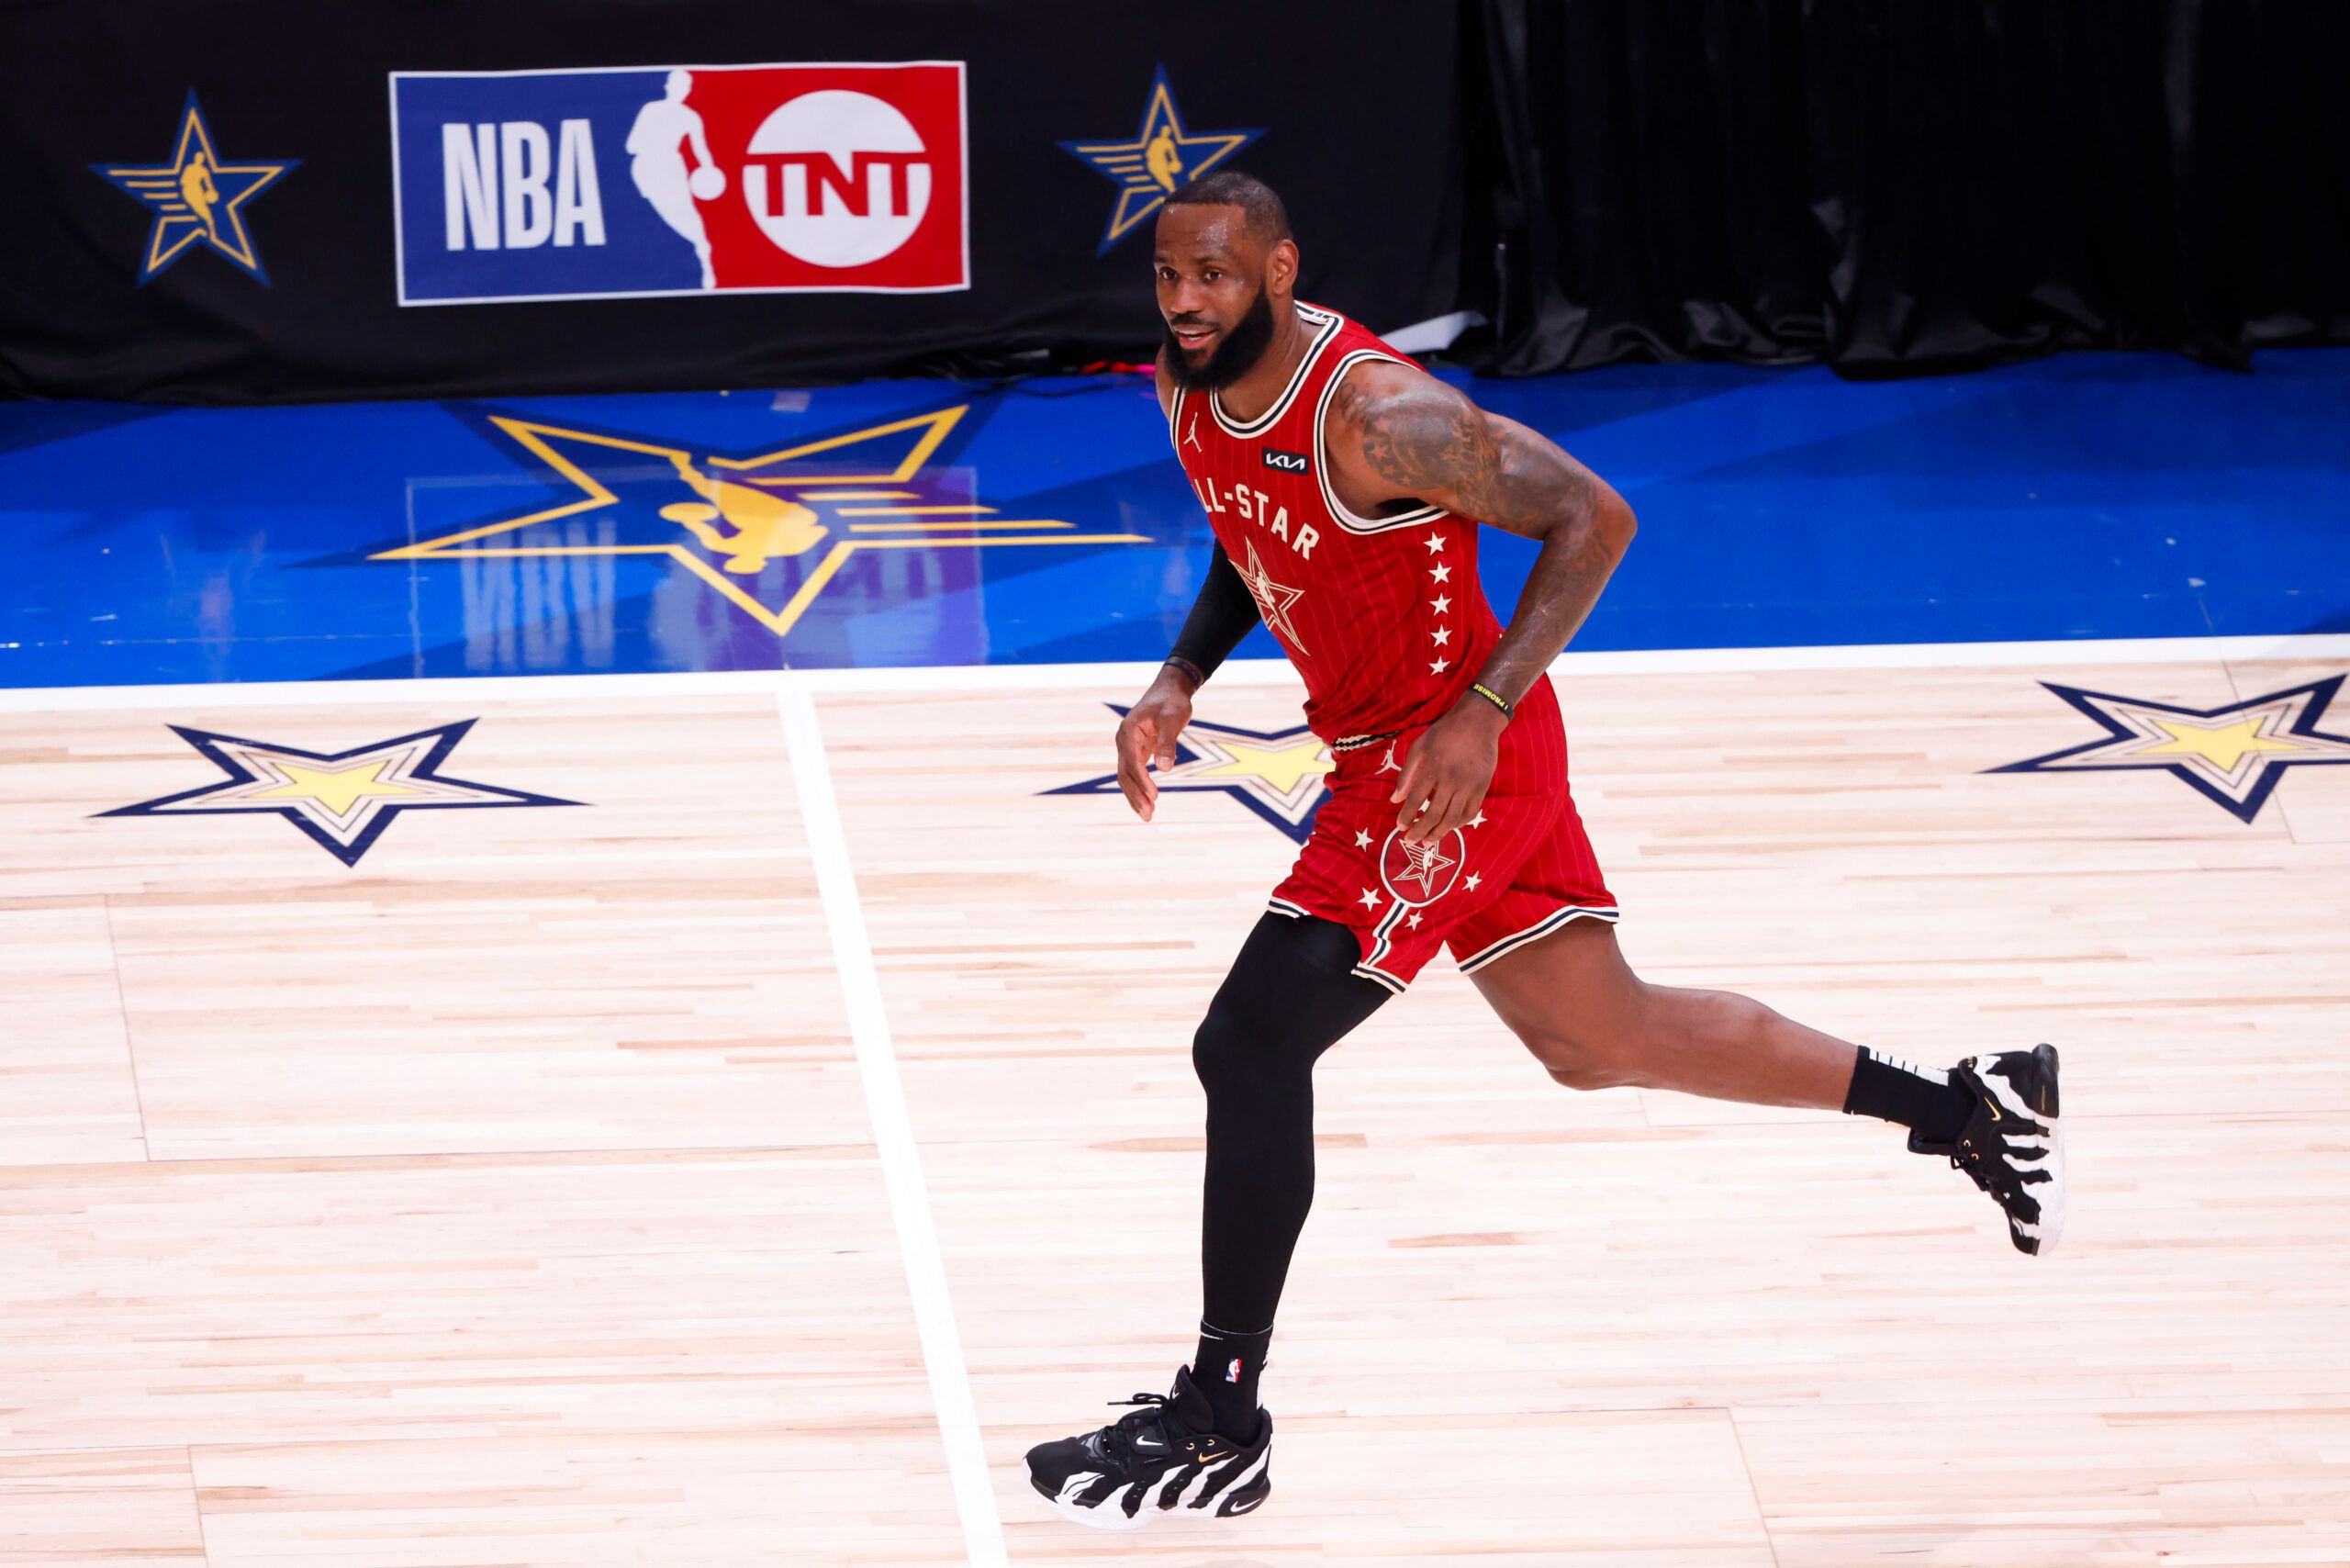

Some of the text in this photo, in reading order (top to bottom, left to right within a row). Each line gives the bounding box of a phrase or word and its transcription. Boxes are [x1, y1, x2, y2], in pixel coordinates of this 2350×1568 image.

[442, 118, 606, 251] NBA
[744, 151, 930, 217] TNT
[1266, 453, 1305, 470] KIA
[1194, 477, 1320, 561] LL-STAR
[1473, 683, 1505, 707] PROMISE
